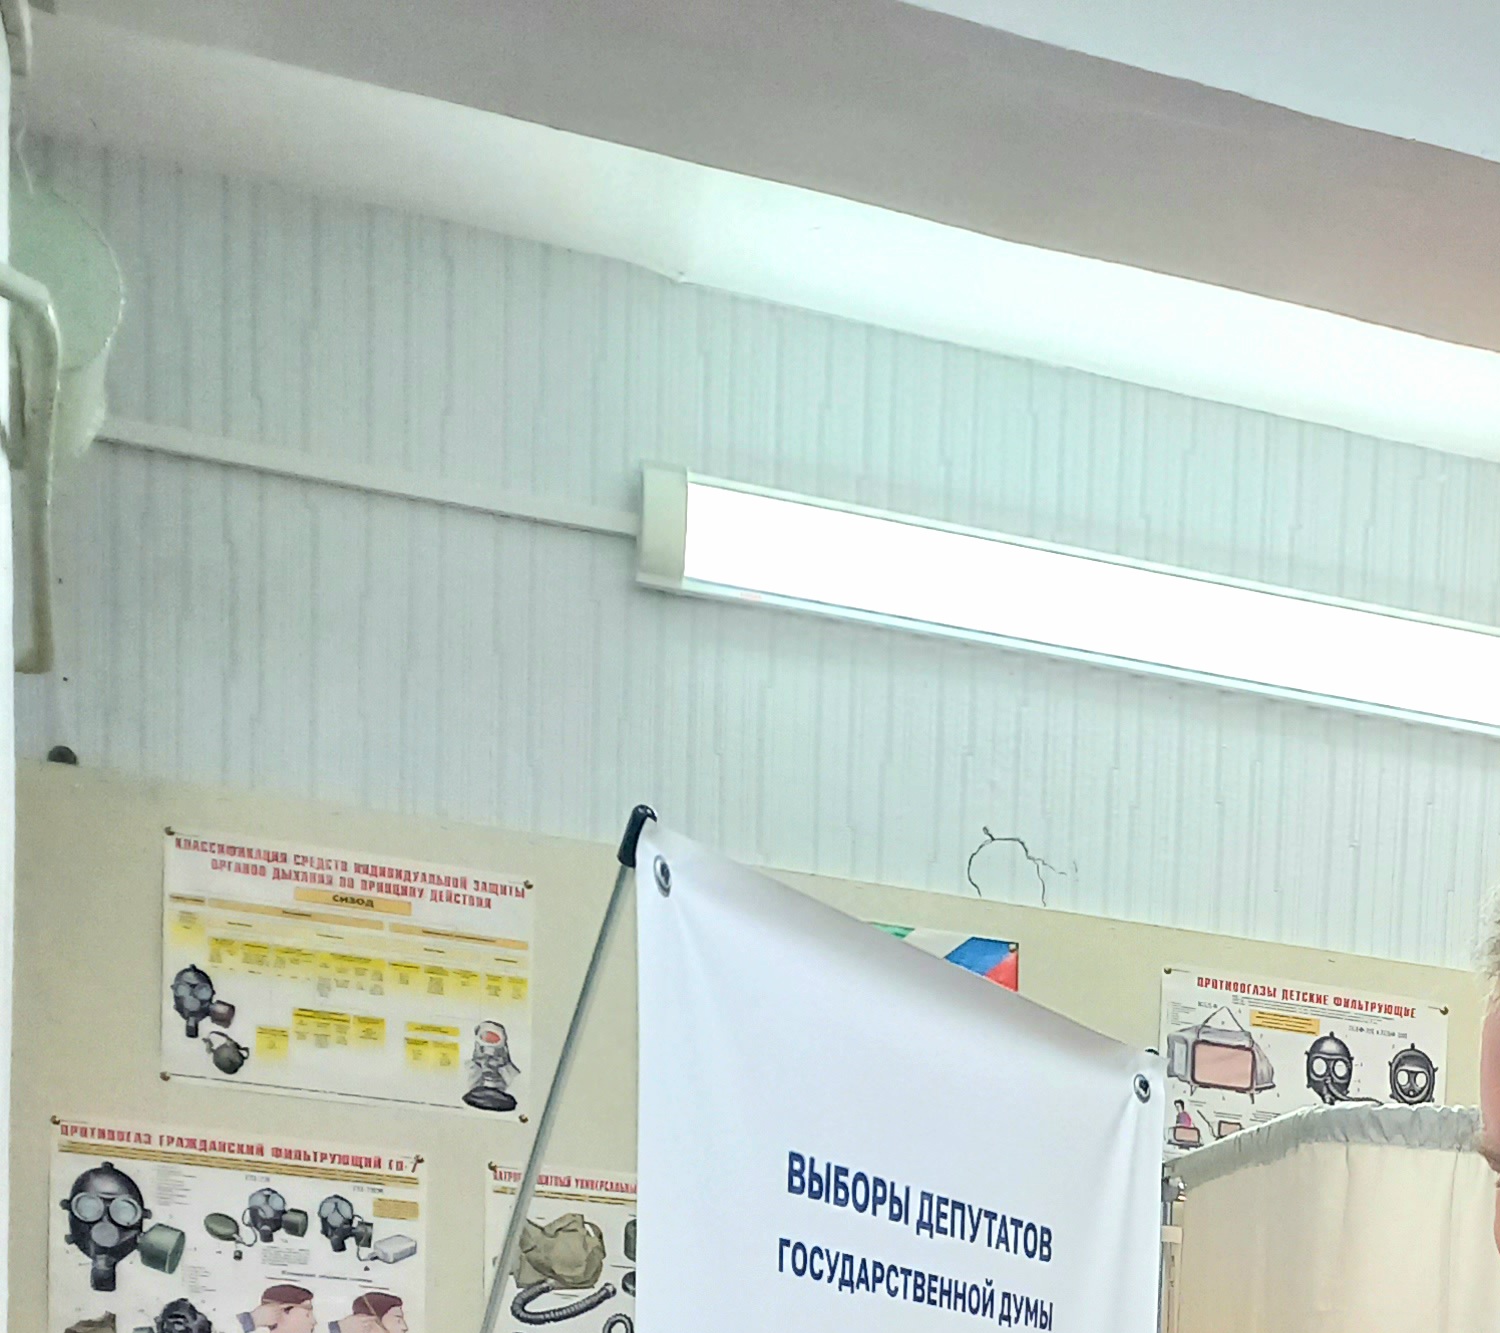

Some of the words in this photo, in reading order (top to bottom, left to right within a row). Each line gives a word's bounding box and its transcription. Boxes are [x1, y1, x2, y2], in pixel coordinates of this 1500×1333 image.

[293, 854, 348, 873] СРЕДСТВ
[473, 879, 526, 899] ЗАЩИТЫ
[332, 894, 374, 908] СИЗОД
[1197, 976, 1277, 998] ПРОТИВОГАЗЫ
[1281, 988, 1329, 1006] ДЕТСКИЕ
[1333, 996, 1416, 1019] ФИЛЬТРУЮЩИЕ
[60, 1124, 152, 1145] ПРОТИВОГАЗ
[159, 1134, 265, 1157] ГРАЖДАНСКИЙ
[271, 1146, 382, 1170] ФИЛЬТРУЮЩИЙ
[787, 1150, 911, 1226] ВЫБОРЫ
[915, 1190, 1053, 1263] ДЕПУТАТОВ
[778, 1237, 995, 1320] ГОСУДАРСТВЕННОЙ
[998, 1291, 1054, 1331] ДУМЫ
